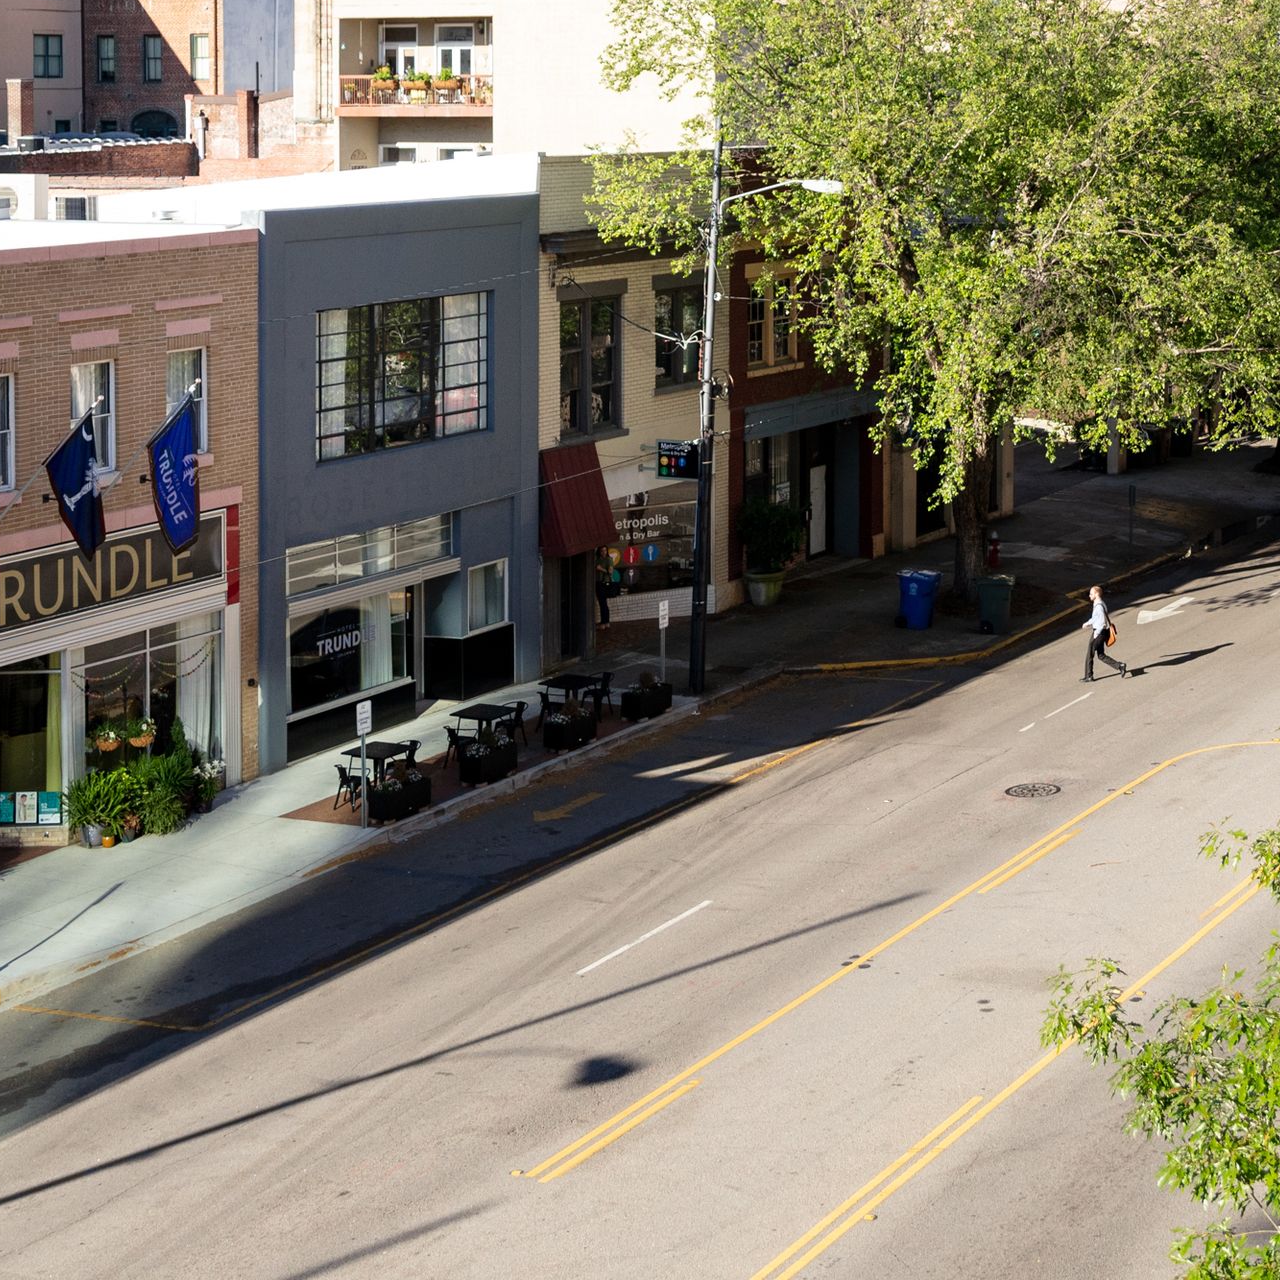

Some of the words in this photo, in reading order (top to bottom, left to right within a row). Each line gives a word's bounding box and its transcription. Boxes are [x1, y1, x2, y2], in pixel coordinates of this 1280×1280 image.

[615, 513, 669, 530] etropolis
[633, 532, 645, 540] Dry
[647, 530, 660, 538] Bar
